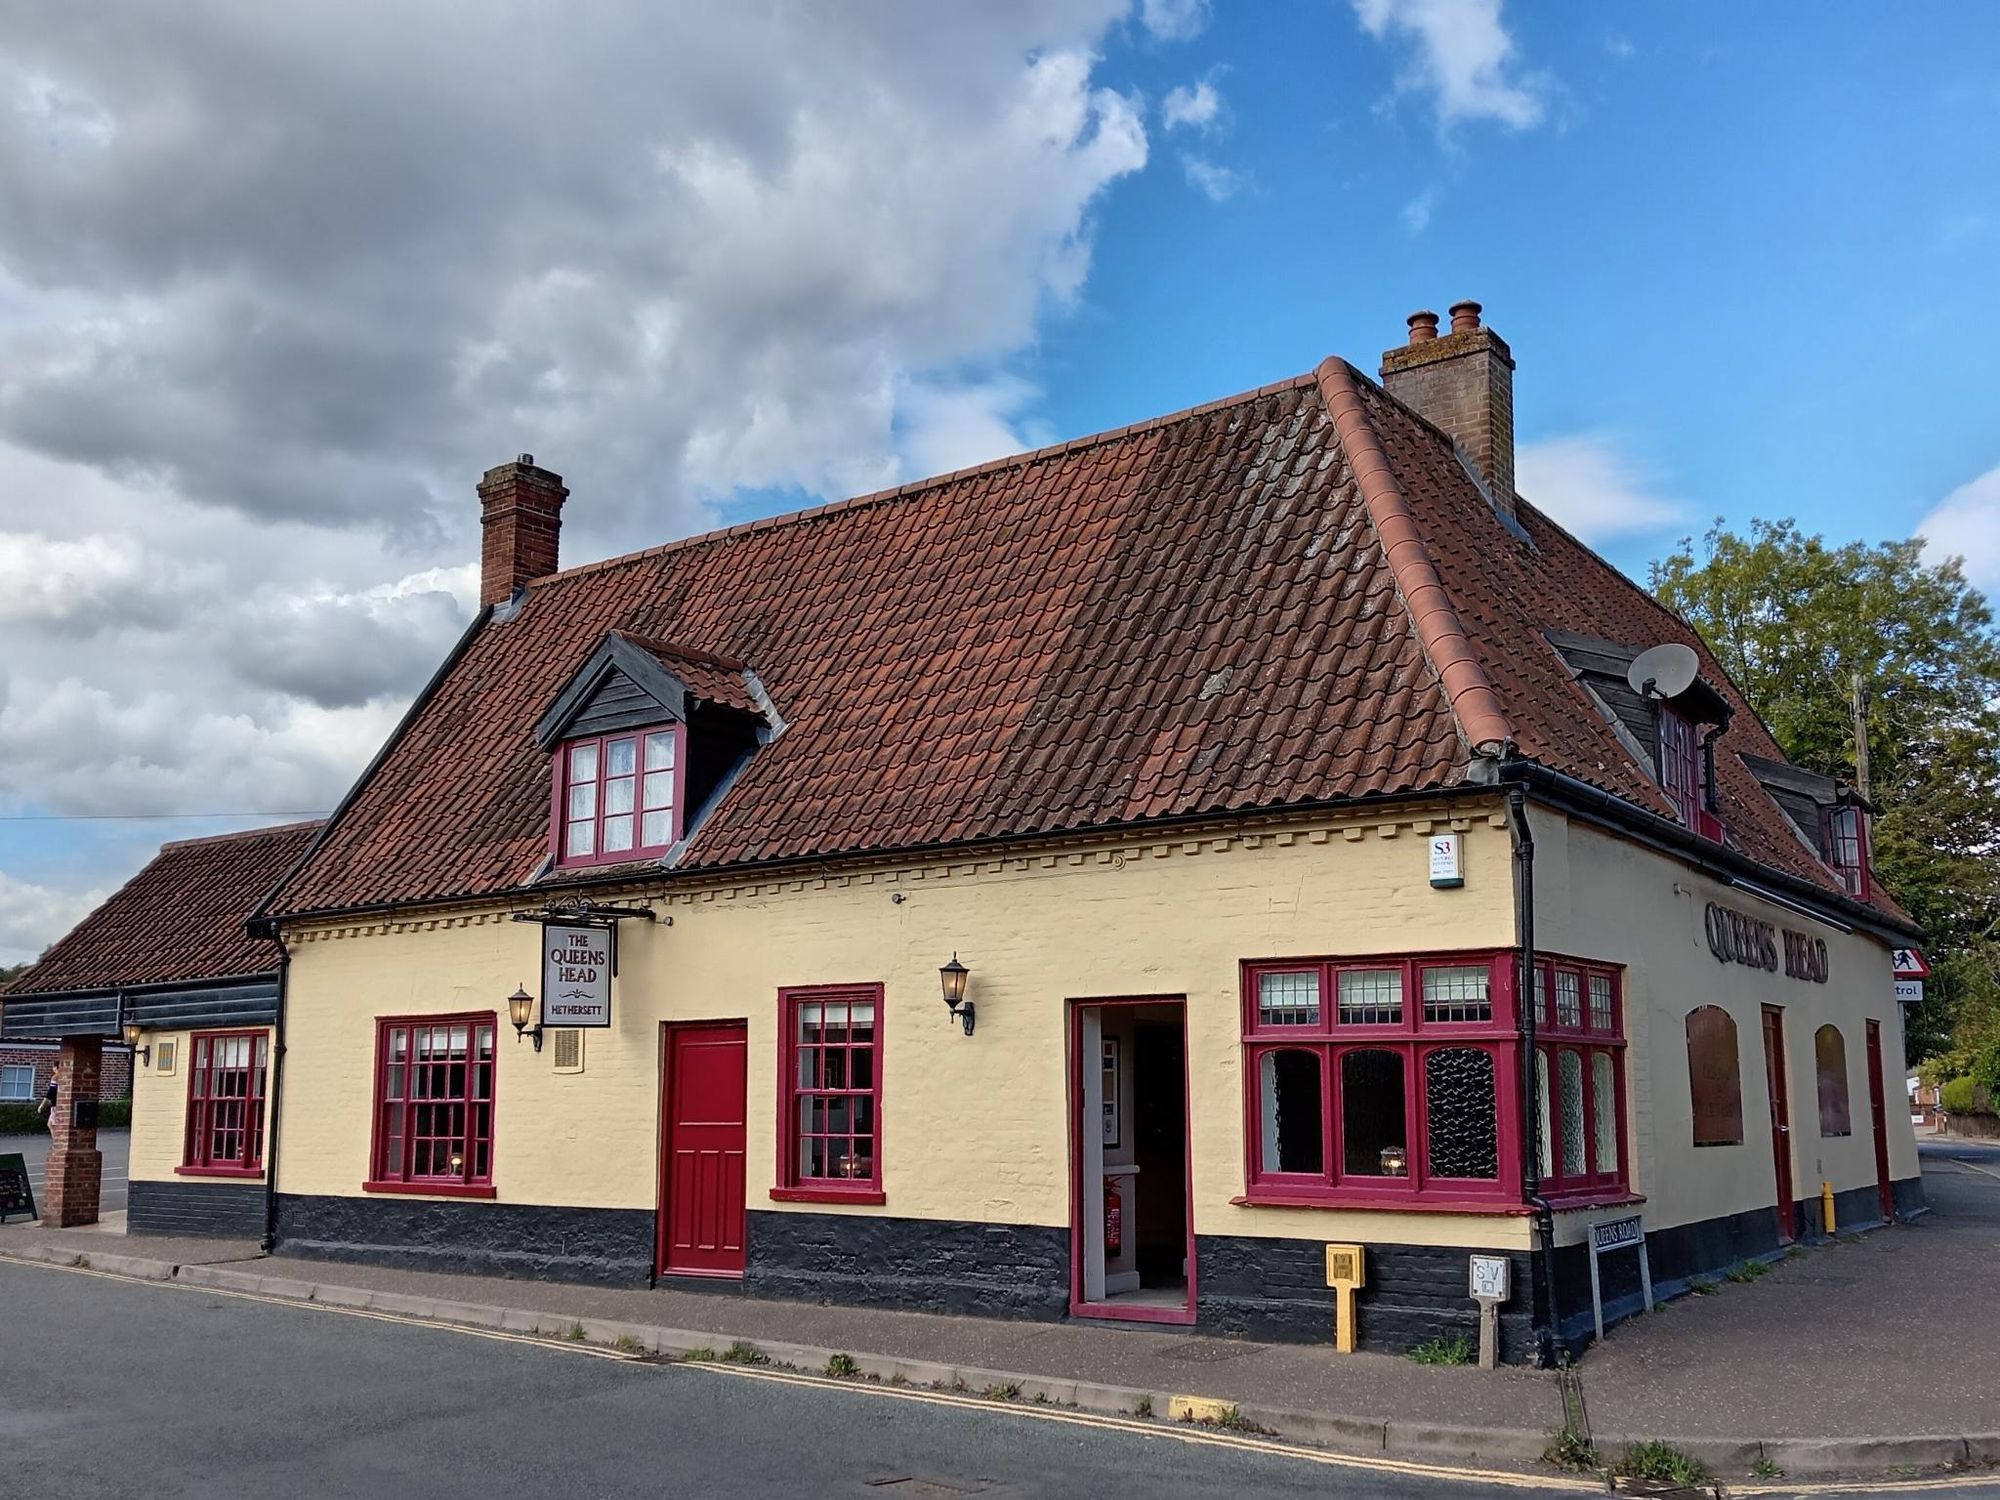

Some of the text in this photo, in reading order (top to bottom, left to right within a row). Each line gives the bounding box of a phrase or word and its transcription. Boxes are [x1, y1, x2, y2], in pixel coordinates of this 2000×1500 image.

[1434, 841, 1451, 855] S3
[568, 934, 589, 947] THE
[550, 948, 605, 966] QUEENS
[1782, 928, 1828, 984] HEAD
[558, 967, 597, 983] HEAD
[551, 1004, 602, 1016] HETHERSETT
[1618, 1220, 1637, 1240] ROAD
